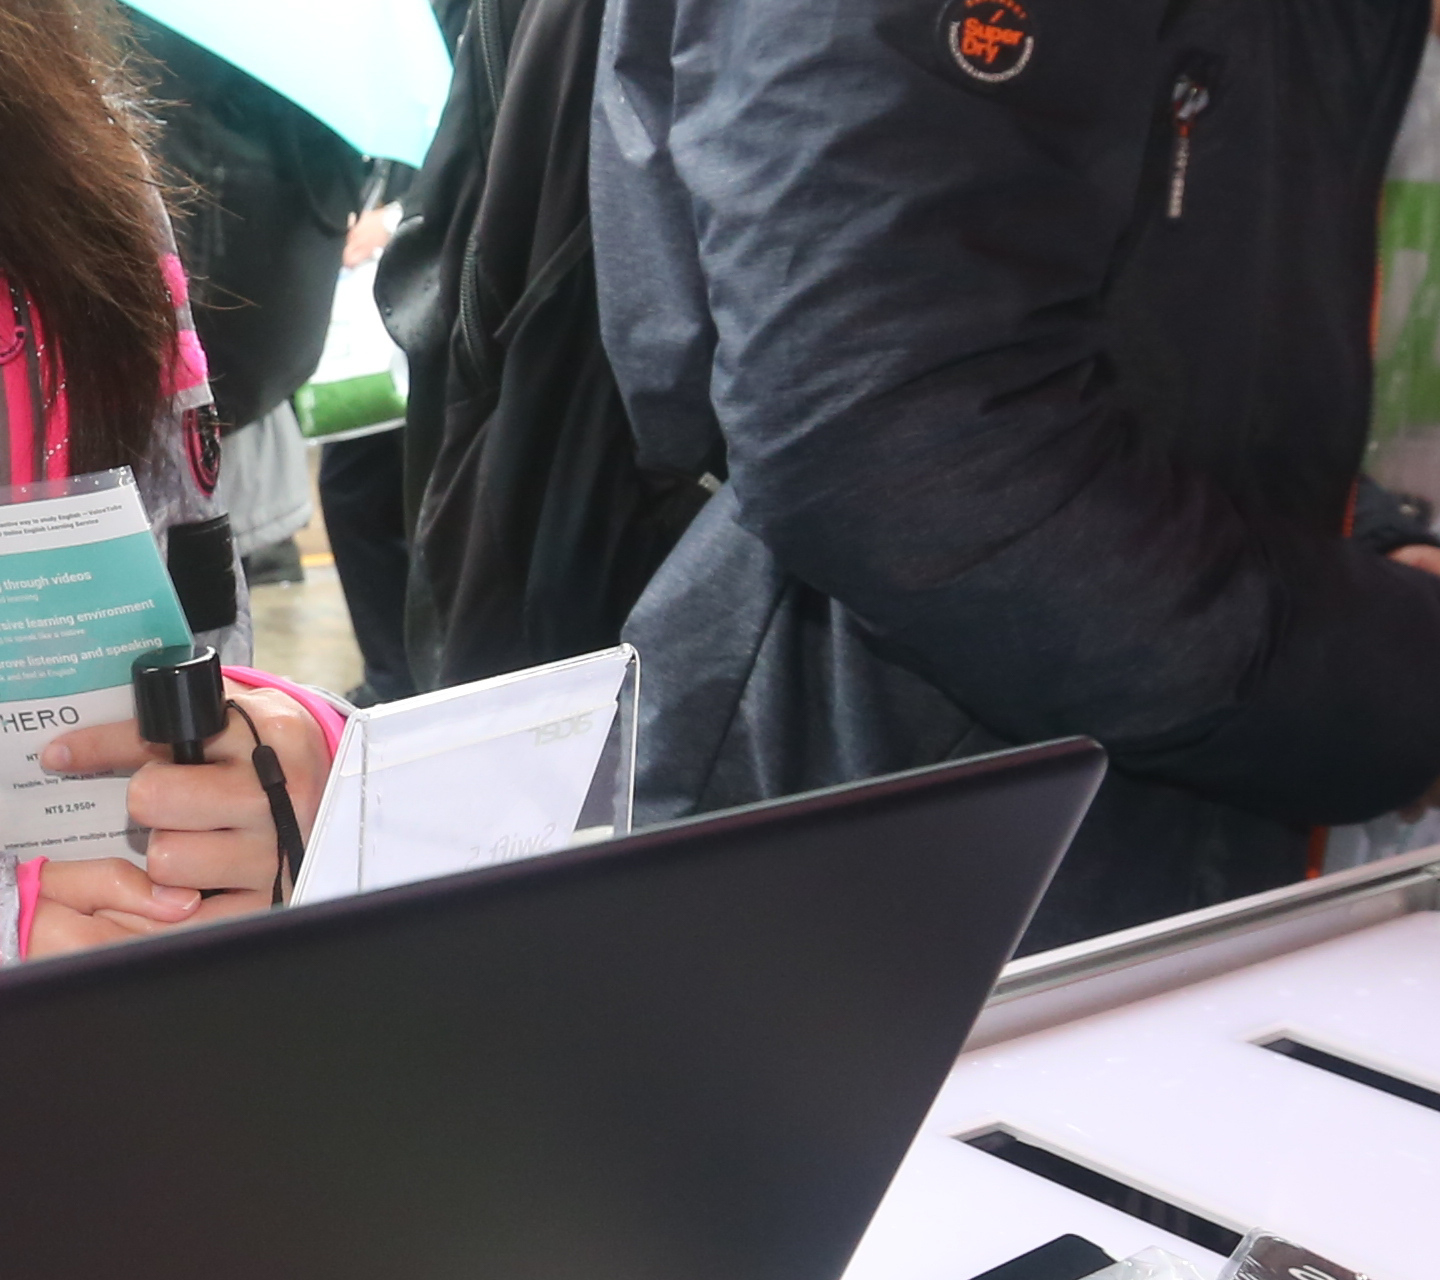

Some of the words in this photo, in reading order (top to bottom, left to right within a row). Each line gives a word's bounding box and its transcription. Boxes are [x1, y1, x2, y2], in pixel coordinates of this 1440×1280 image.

[2, 575, 49, 590] through
[50, 571, 91, 584] videos
[25, 614, 74, 628] learning
[76, 598, 154, 622] environment
[26, 652, 78, 666] listening
[80, 646, 103, 660] and
[104, 637, 163, 656] speaking
[0, 705, 79, 732] HERO
[44, 804, 63, 814] NT$
[65, 801, 95, 812] 2,950+
